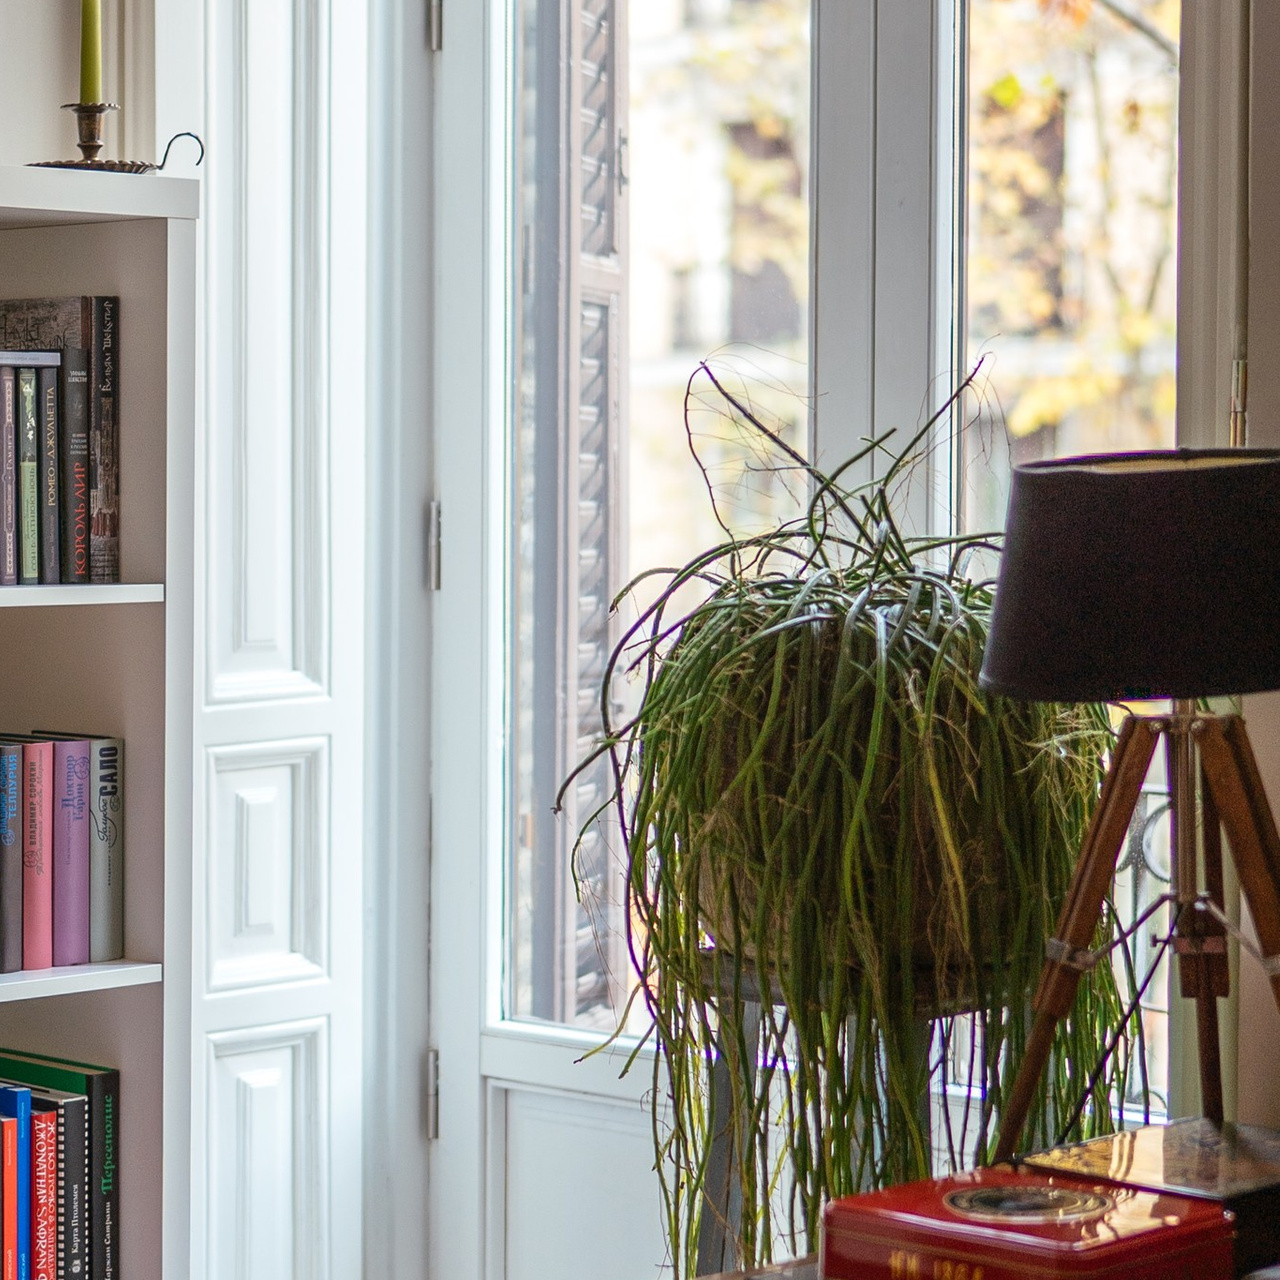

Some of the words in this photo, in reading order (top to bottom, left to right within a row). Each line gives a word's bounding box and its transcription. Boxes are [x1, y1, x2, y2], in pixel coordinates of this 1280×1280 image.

[46, 386, 56, 460] ДЖУЛЬЕТТА
[46, 467, 56, 507] РОМЕО
[73, 461, 87, 500] ЛИР
[74, 502, 87, 575] КОРОЛЬ
[8, 754, 17, 818] ТЕЛЛУРИЯ
[29, 761, 37, 798] СОРОКИН
[61, 754, 76, 811] Доктор
[98, 746, 118, 797] САЛО
[29, 801, 37, 846] ВЛАДИМИР
[73, 782, 85, 821] Гарин
[46, 1120, 56, 1170] ЖУТКО
[100, 1094, 116, 1195] Персеполис
[70, 1184, 80, 1227] Птолемея
[71, 1227, 80, 1254] Карта
